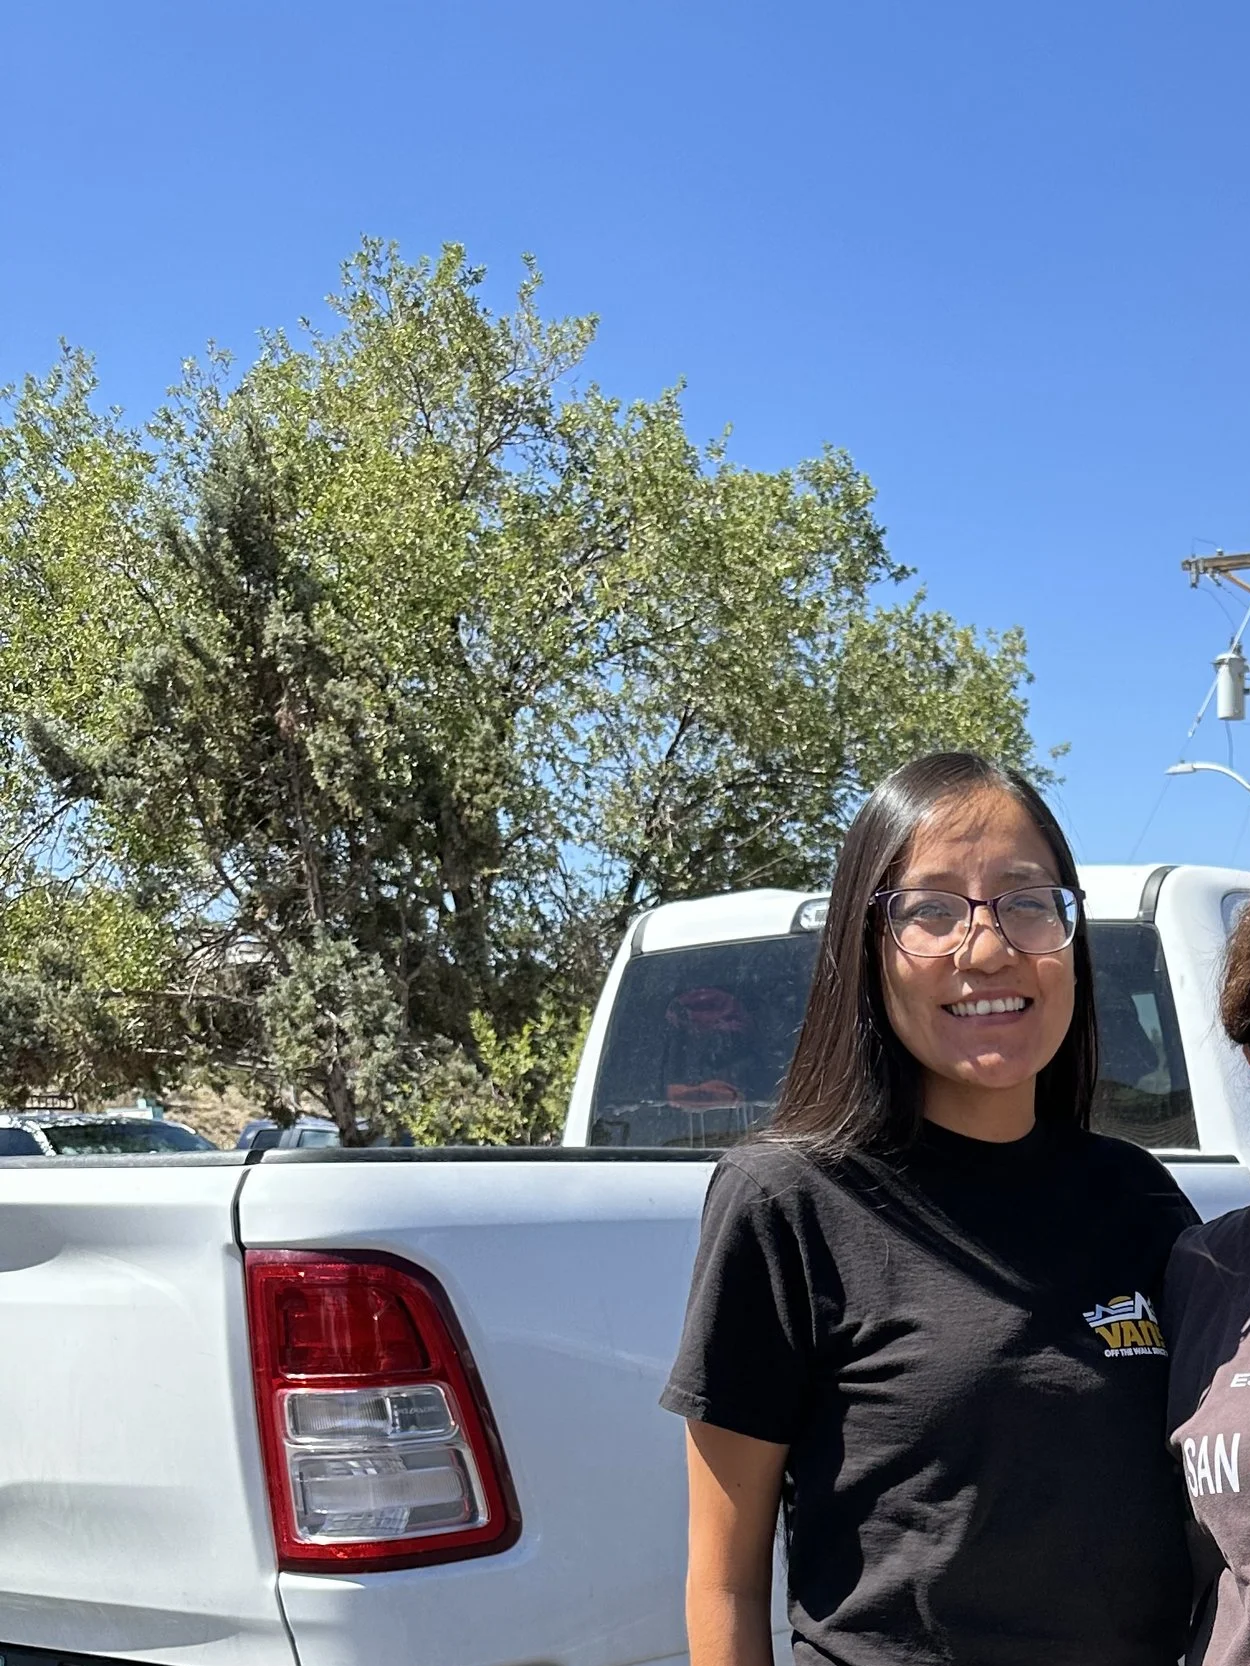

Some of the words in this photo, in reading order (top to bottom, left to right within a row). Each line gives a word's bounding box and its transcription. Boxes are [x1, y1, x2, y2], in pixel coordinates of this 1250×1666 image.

[1104, 1349, 1120, 1358] OFF
[1120, 1348, 1134, 1357] THE
[1184, 1433, 1241, 1498] SAN
